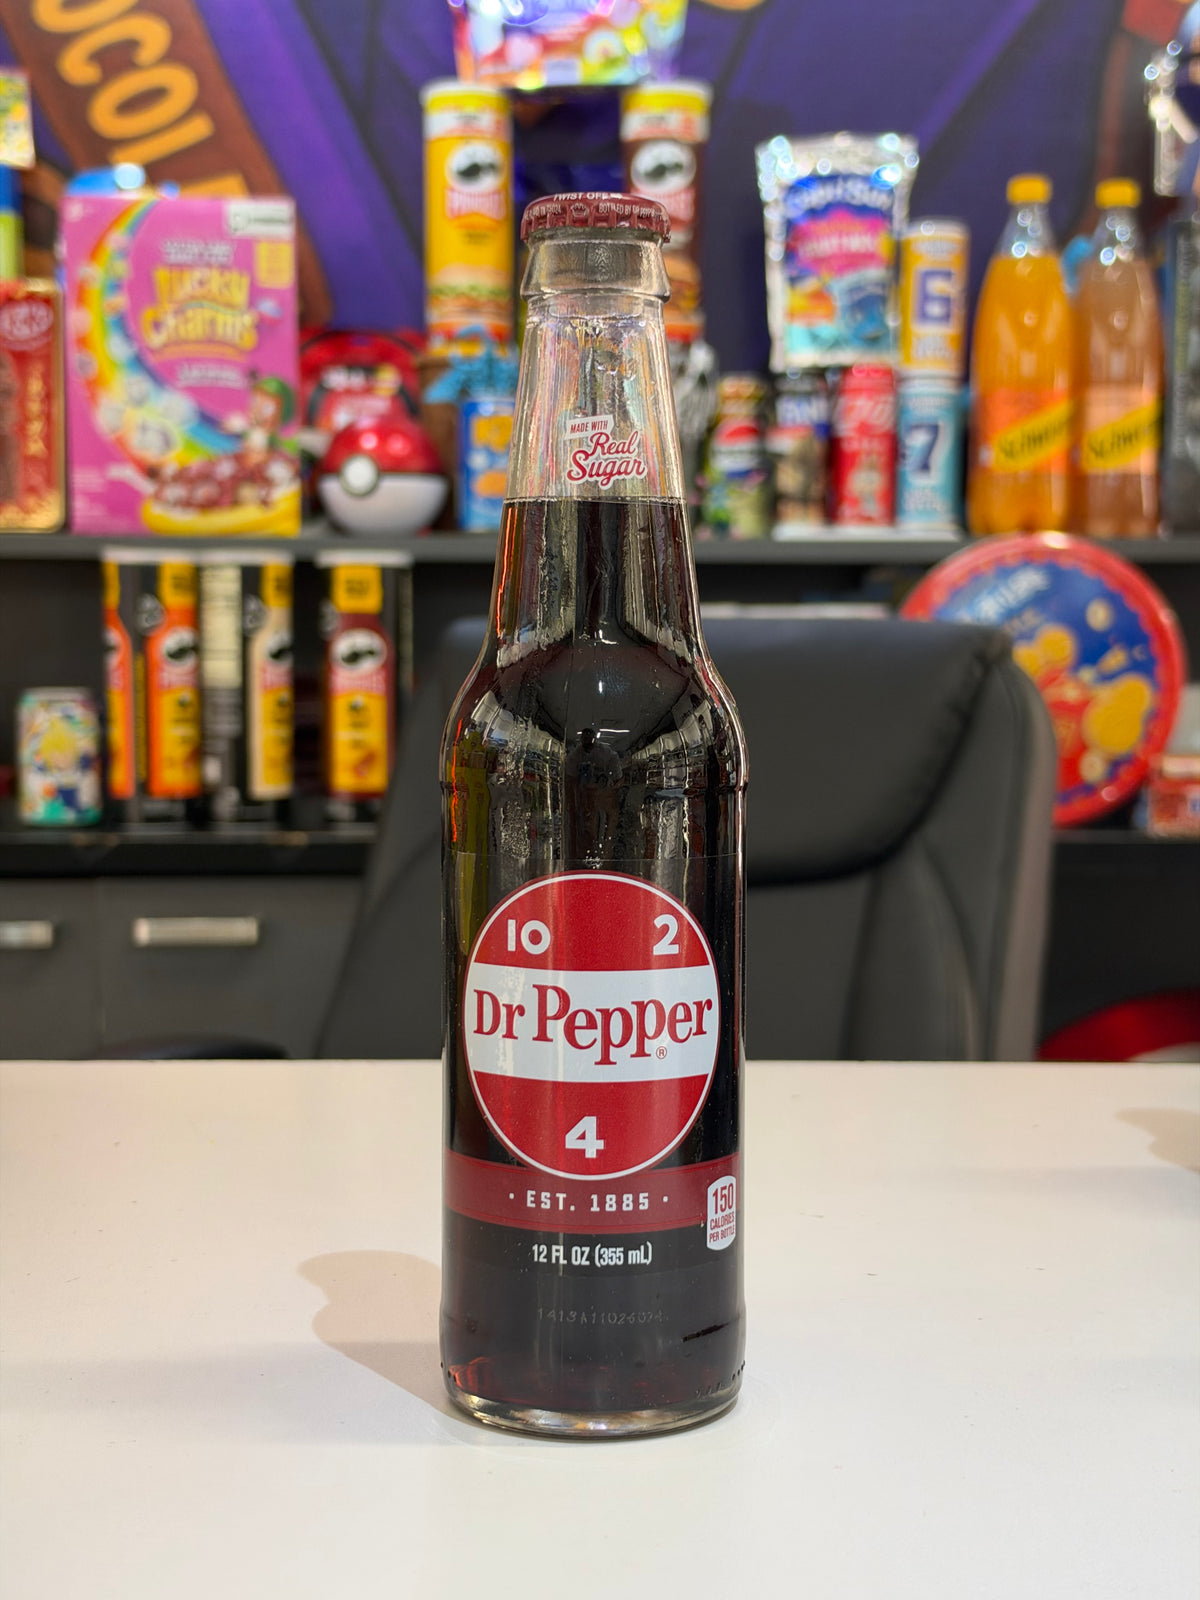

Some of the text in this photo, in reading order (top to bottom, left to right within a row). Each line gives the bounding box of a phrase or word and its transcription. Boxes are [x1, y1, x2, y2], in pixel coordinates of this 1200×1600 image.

[553, 192, 583, 201] TWIST
[570, 420, 609, 434] MADE WITH
[589, 430, 639, 456] Real
[566, 449, 646, 487] Sugar
[507, 919, 551, 955] 10
[653, 914, 680, 955] 2
[473, 983, 713, 1066] Dr Pepper
[565, 1116, 604, 1158] 4
[526, 1189, 650, 1212] EST. 1885
[712, 1182, 734, 1215] 150
[709, 1211, 735, 1230] CALORIES
[709, 1224, 735, 1243] PER BOTTLE
[532, 1241, 653, 1268] 12 FL OZ (355 mL)
